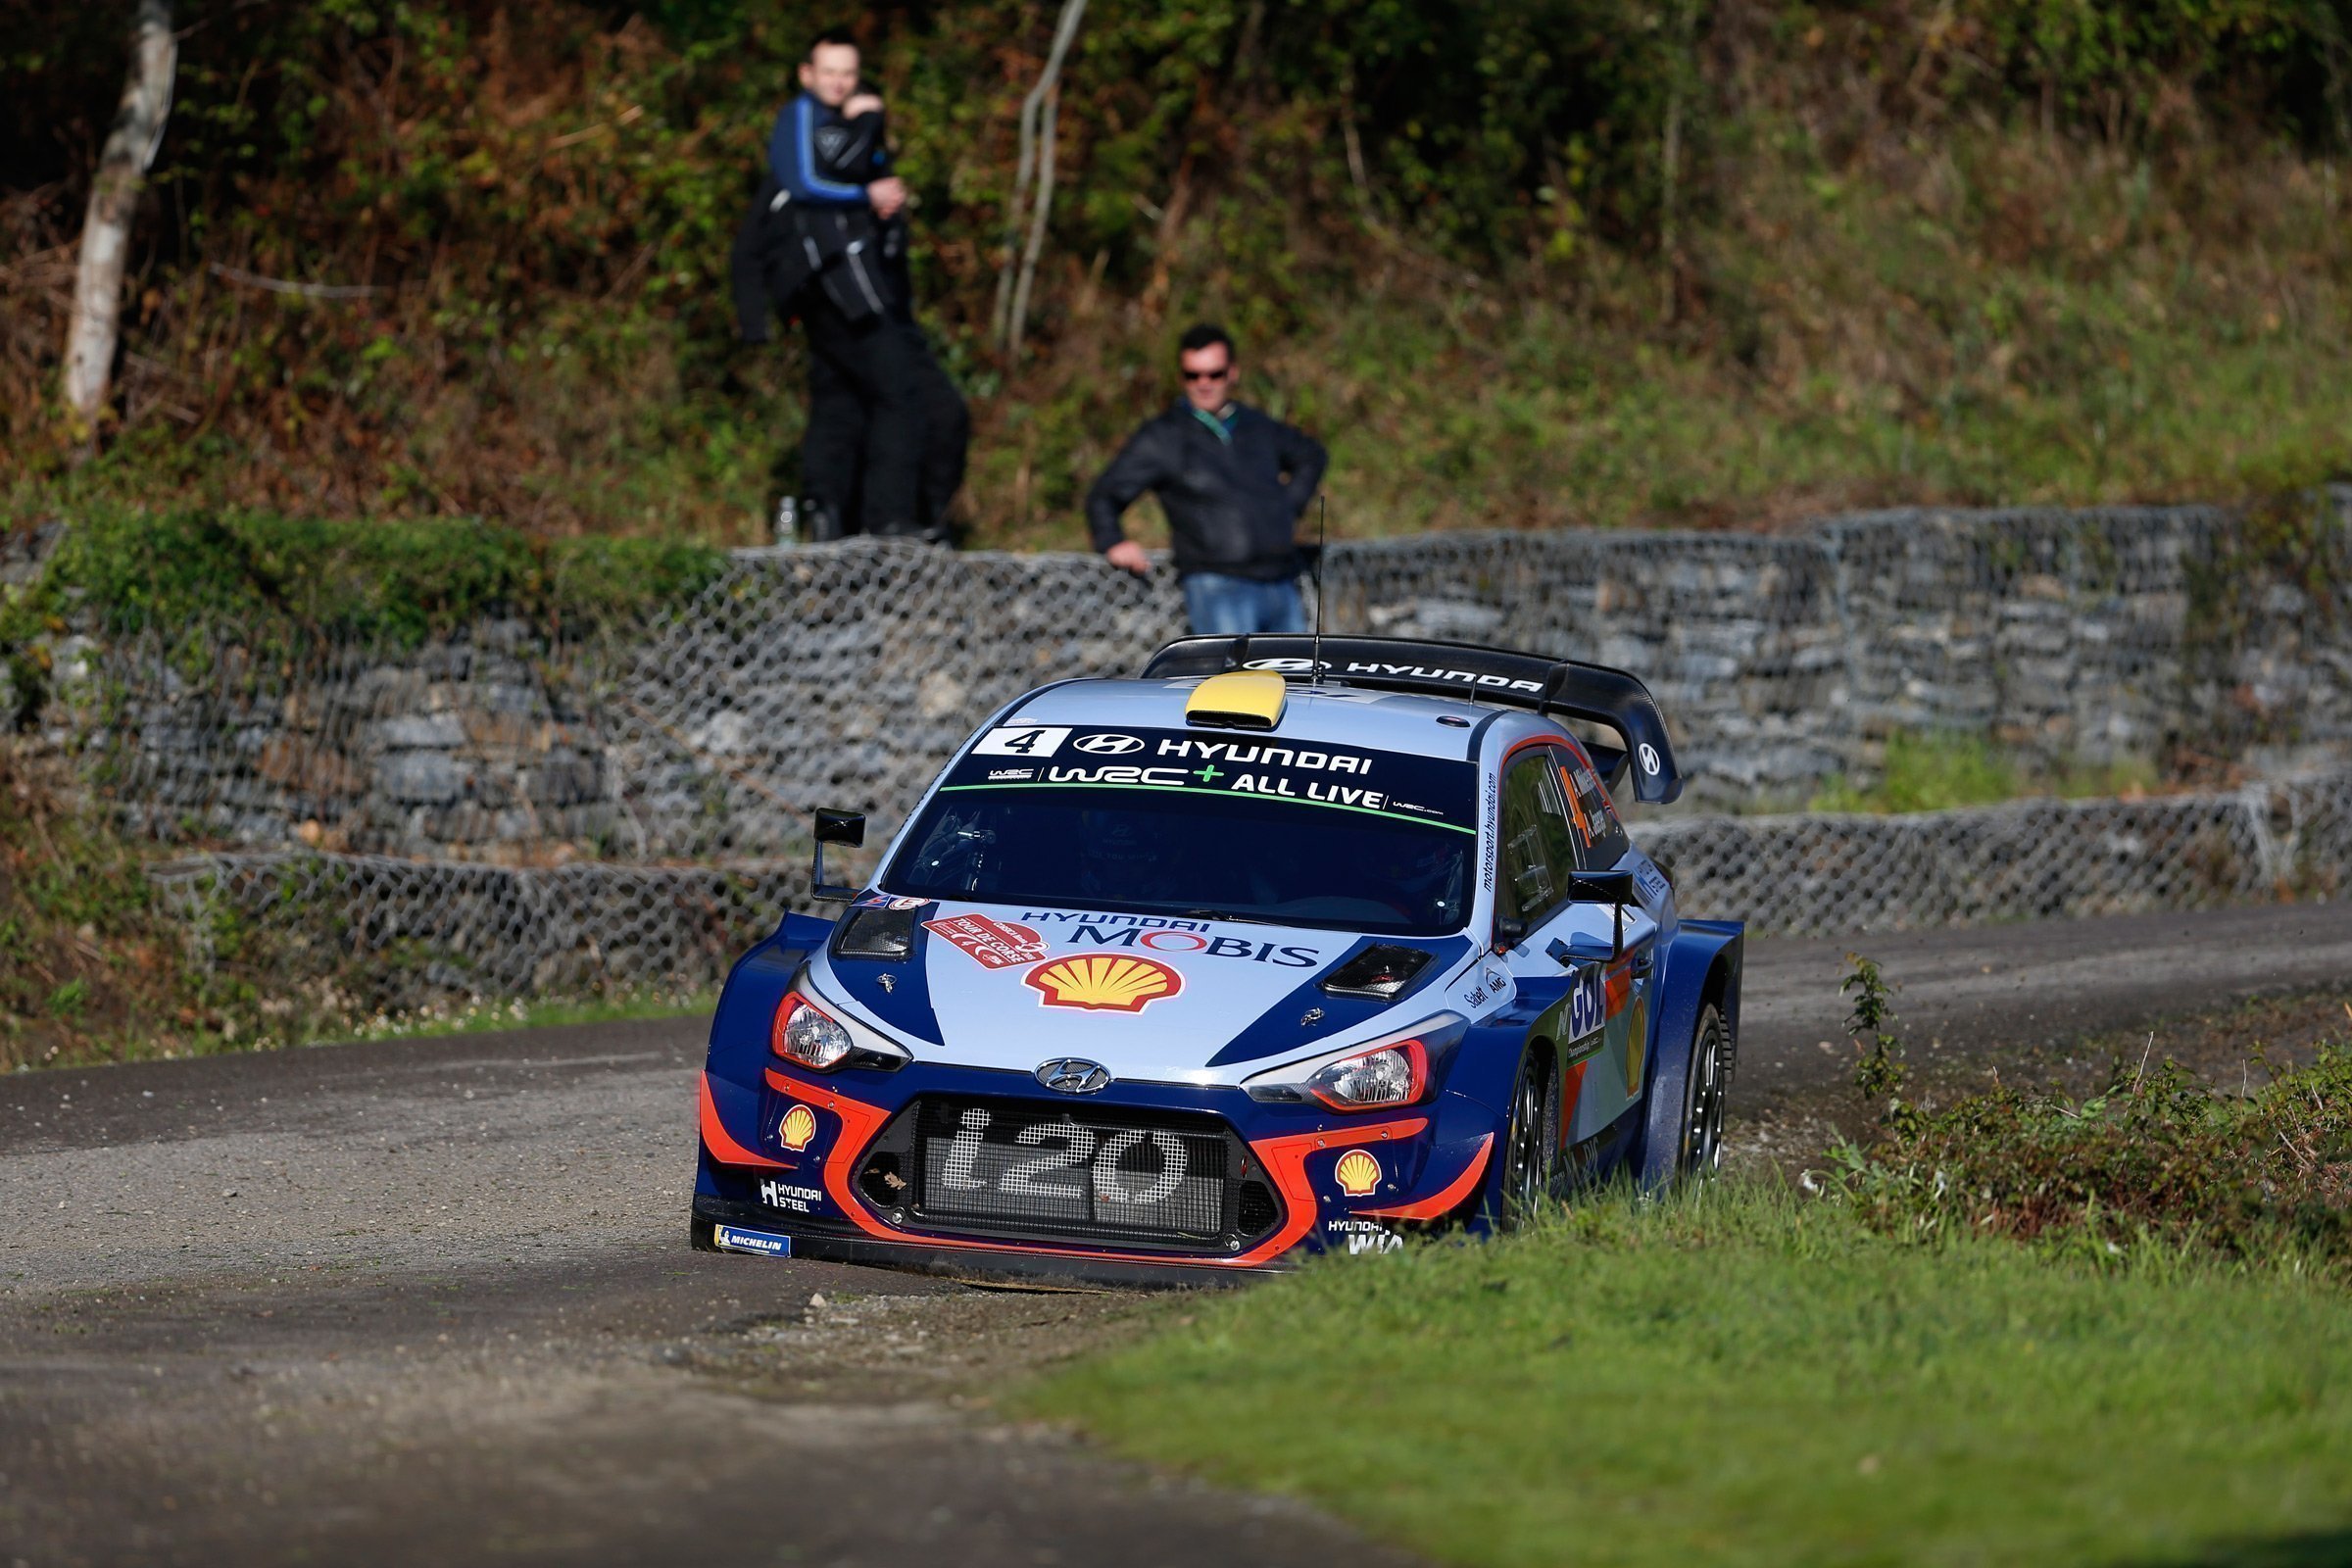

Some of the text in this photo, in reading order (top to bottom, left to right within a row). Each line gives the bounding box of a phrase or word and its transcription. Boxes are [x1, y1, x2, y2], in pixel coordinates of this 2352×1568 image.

[1347, 662, 1544, 693] HYUNDA
[1004, 729, 1045, 754] 4
[1157, 738, 1372, 774] HYUNDAI
[1231, 773, 1296, 796] ALL
[1306, 782, 1384, 809] LIVE
[1483, 772, 1496, 893] motorsport.hyundai.com
[1020, 912, 1211, 932] HYUNDAI
[953, 918, 983, 934] TOUR
[976, 933, 997, 943] DE
[990, 942, 1025, 962] CORSE
[1066, 925, 1320, 968] MOBIS
[941, 1107, 1188, 1204] i20
[778, 1183, 821, 1201] HYUNDAI
[779, 1197, 809, 1212] STEEL
[731, 1235, 782, 1250] MICHELIN
